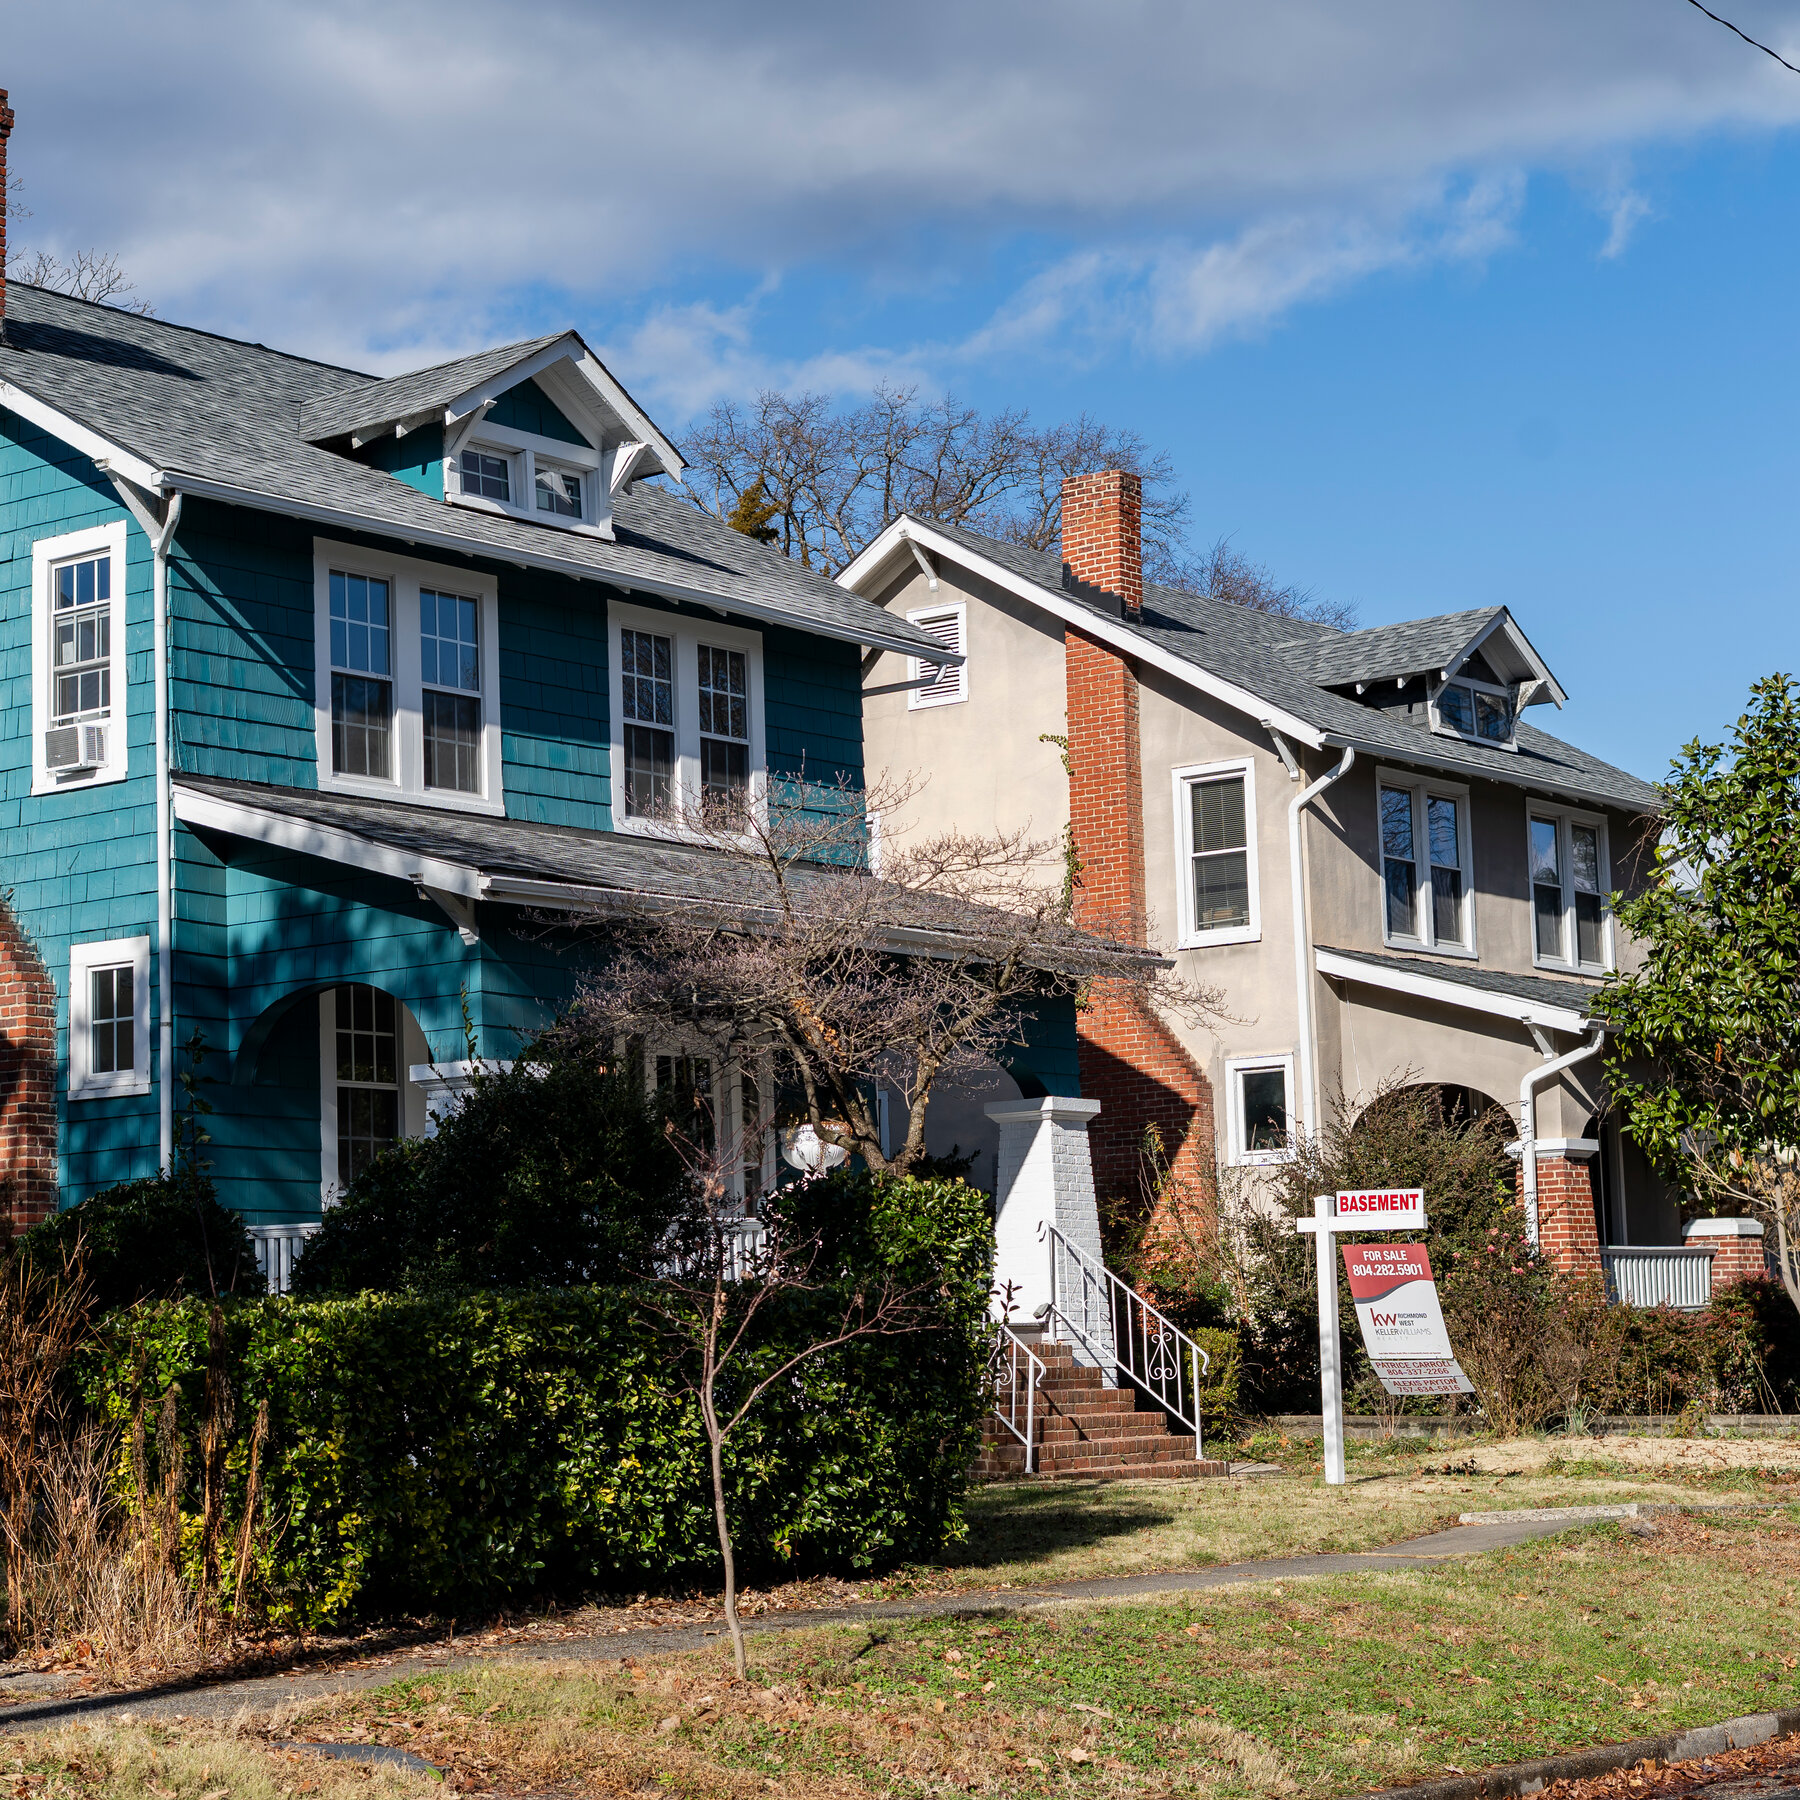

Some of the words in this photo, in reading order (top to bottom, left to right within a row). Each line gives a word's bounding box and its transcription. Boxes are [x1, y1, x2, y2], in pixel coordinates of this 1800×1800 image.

[1340, 1194, 1419, 1212] BASEMENT
[1363, 1250, 1382, 1261] FOR
[1383, 1250, 1407, 1261] SALE
[1352, 1263, 1424, 1276] 804.282.5901
[1412, 1360, 1453, 1368] CARROLL
[1386, 1368, 1450, 1376] 804-337-2266
[1424, 1378, 1458, 1386] PAYTON
[1397, 1385, 1461, 1393] 757-634-5816
